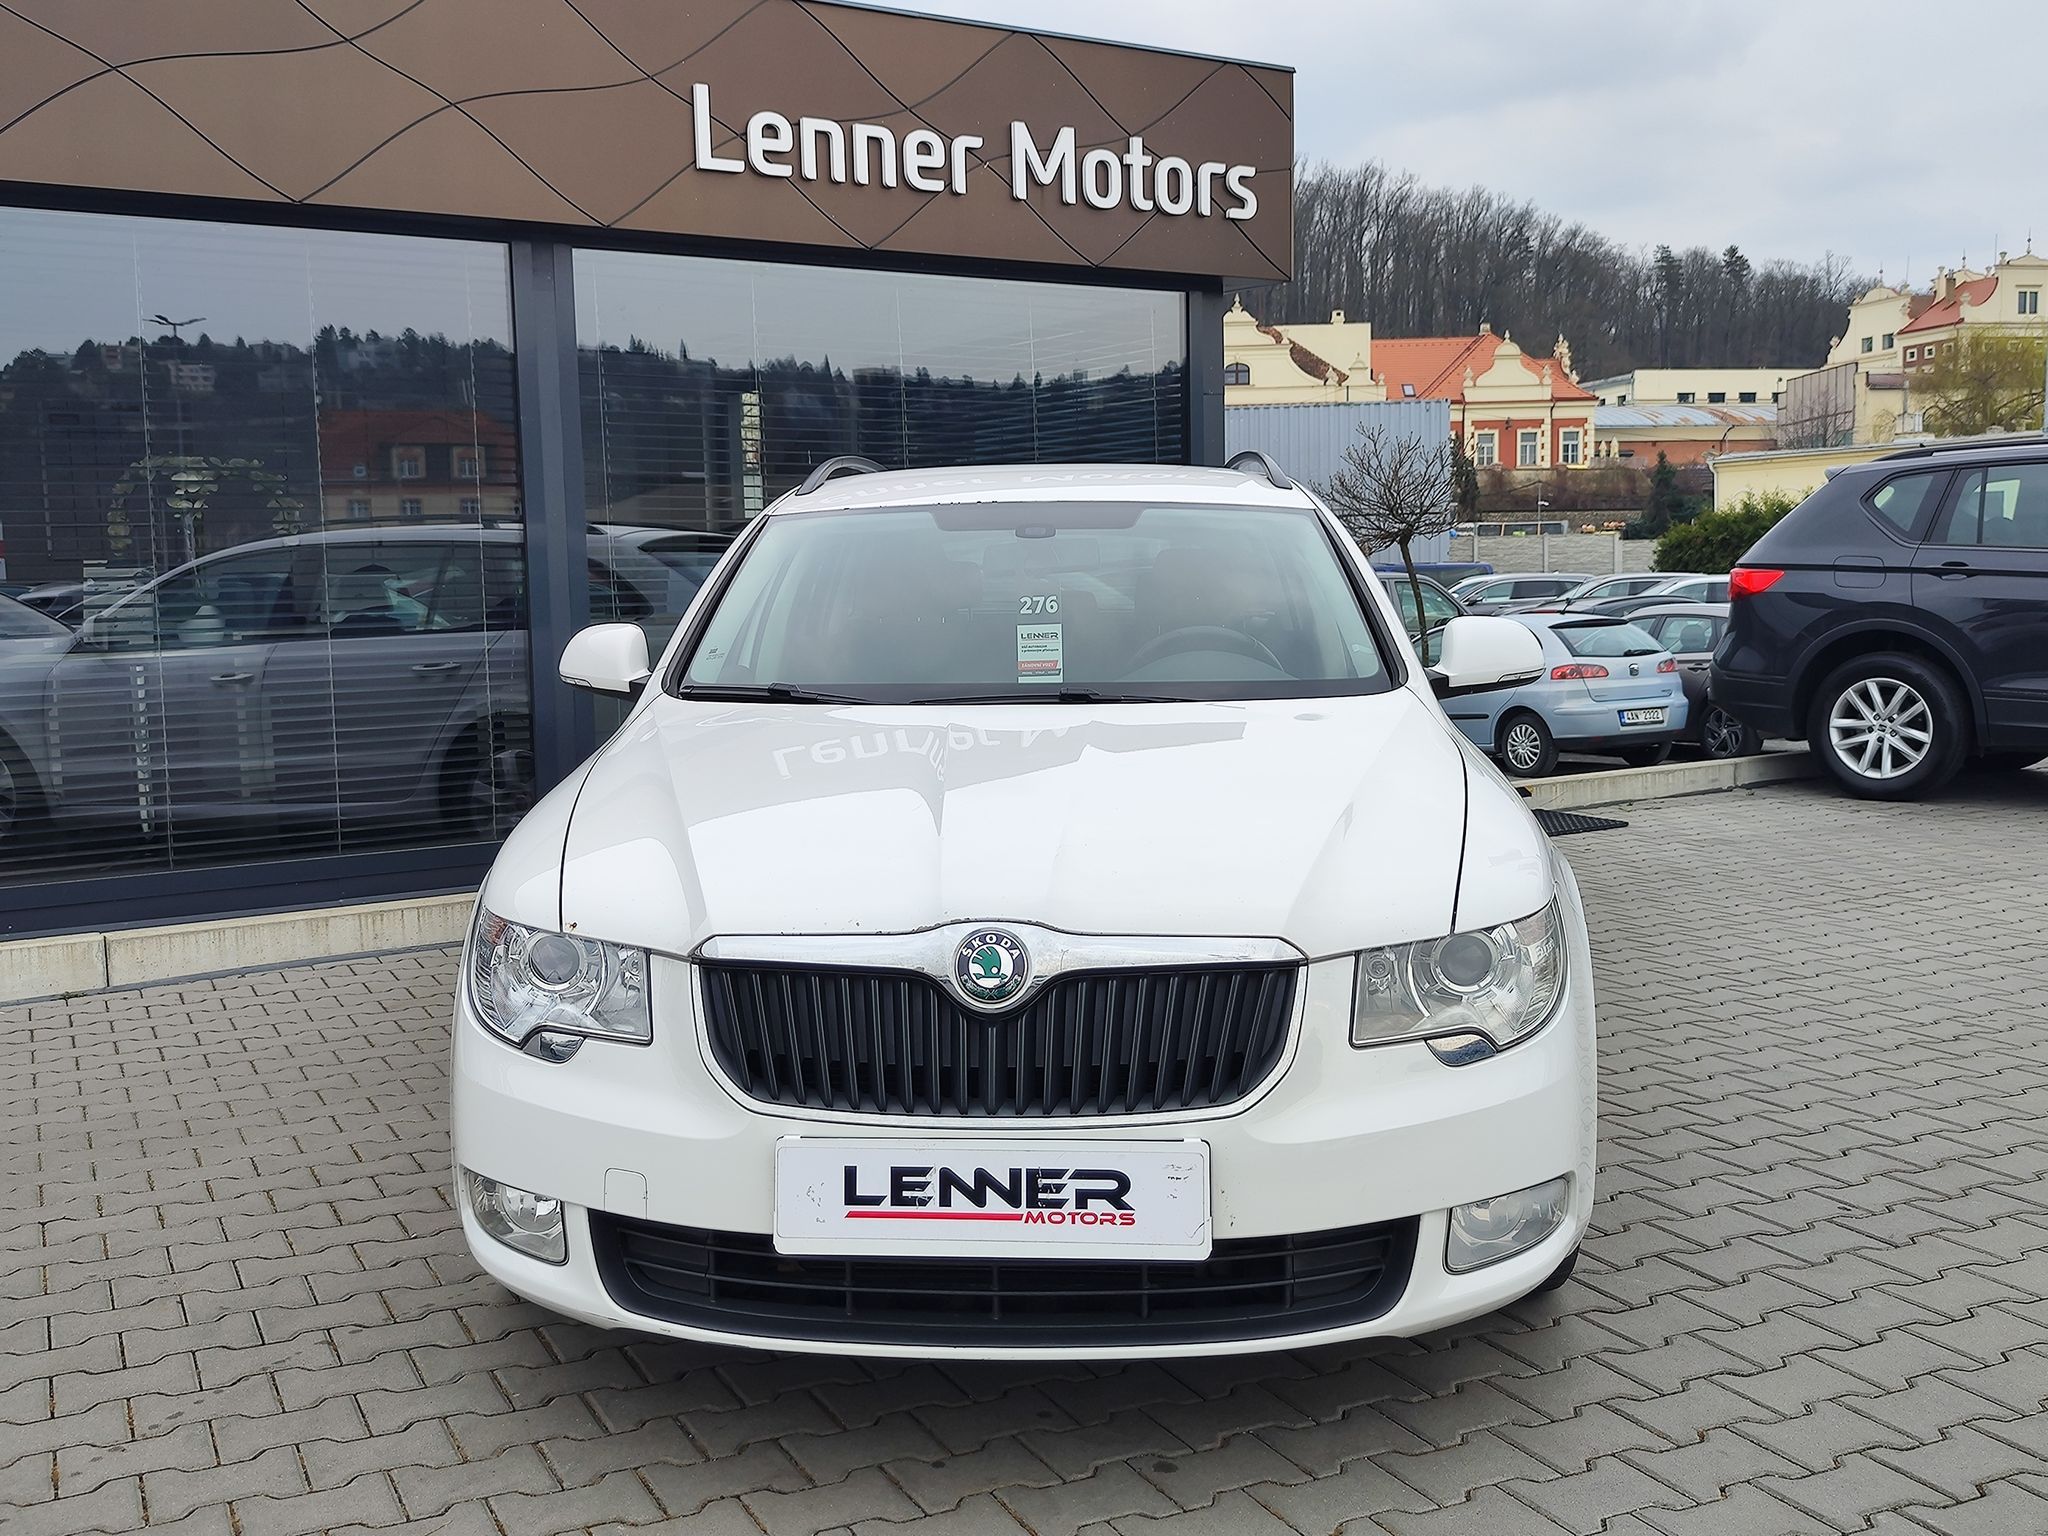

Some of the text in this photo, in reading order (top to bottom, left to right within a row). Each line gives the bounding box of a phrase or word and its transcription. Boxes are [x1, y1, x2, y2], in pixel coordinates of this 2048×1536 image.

[692, 83, 1258, 221] Lenner Motors
[1019, 595, 1059, 614] 276
[1020, 632, 1059, 640] LENNER
[843, 1165, 1136, 1211] LENNER
[1023, 1211, 1136, 1227] MOTORS
